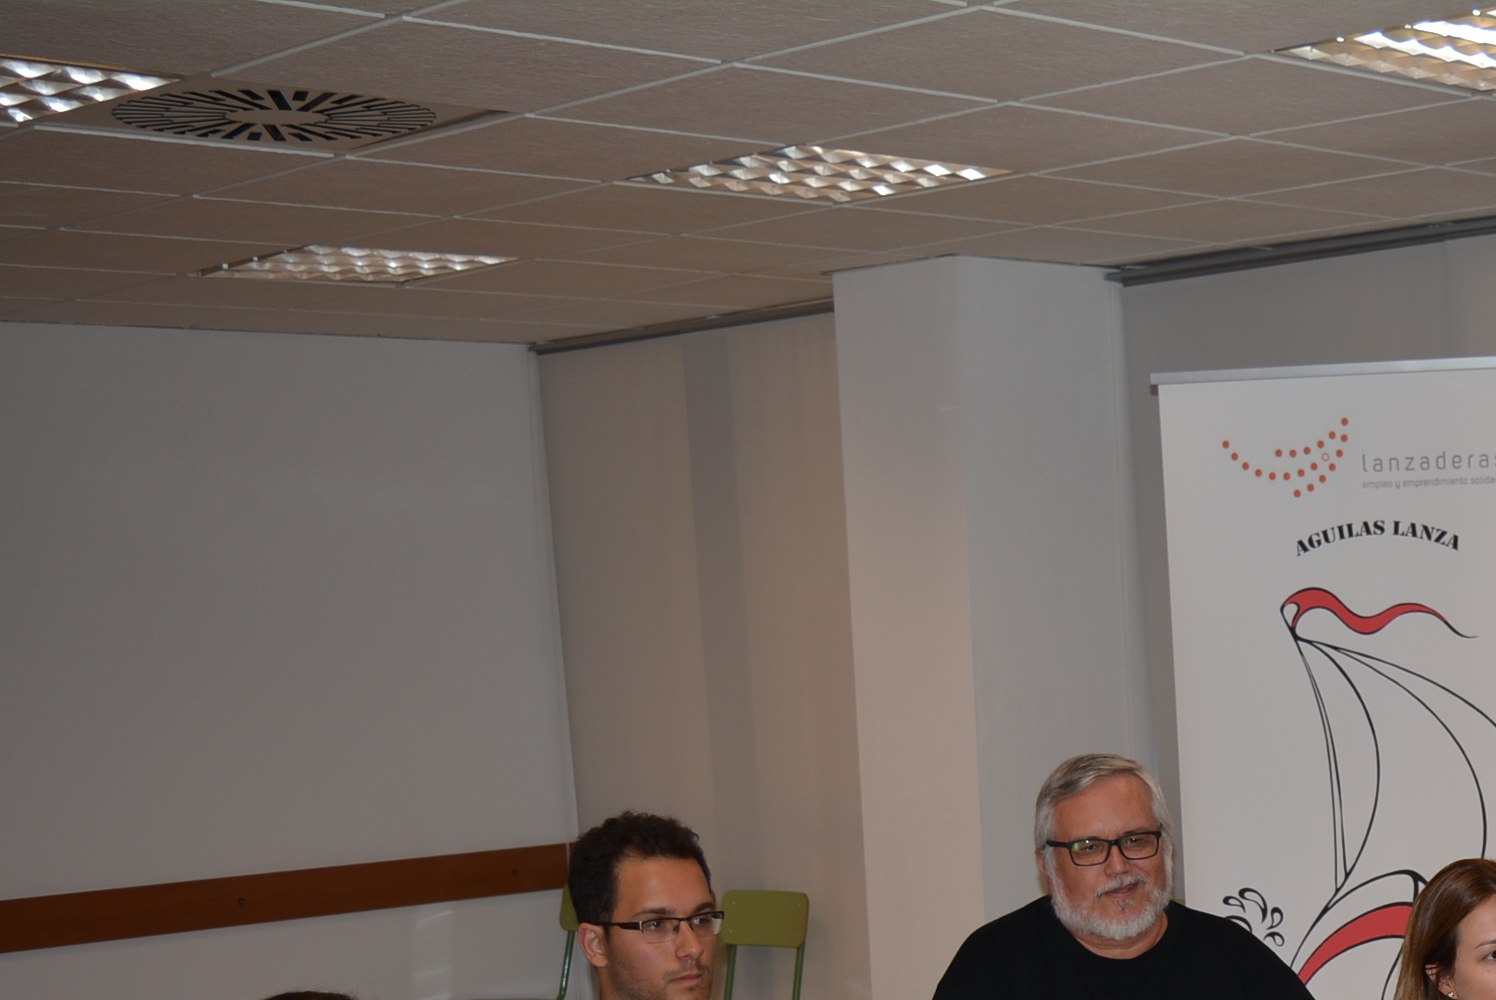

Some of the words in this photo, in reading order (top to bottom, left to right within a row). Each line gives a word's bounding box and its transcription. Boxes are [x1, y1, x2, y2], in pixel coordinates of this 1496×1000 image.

[1362, 479, 1393, 490] empleo
[1395, 481, 1401, 490] y
[1402, 477, 1468, 488] emprendimiento
[1296, 520, 1386, 557] AGUILAS
[1392, 520, 1460, 552] LANZA
